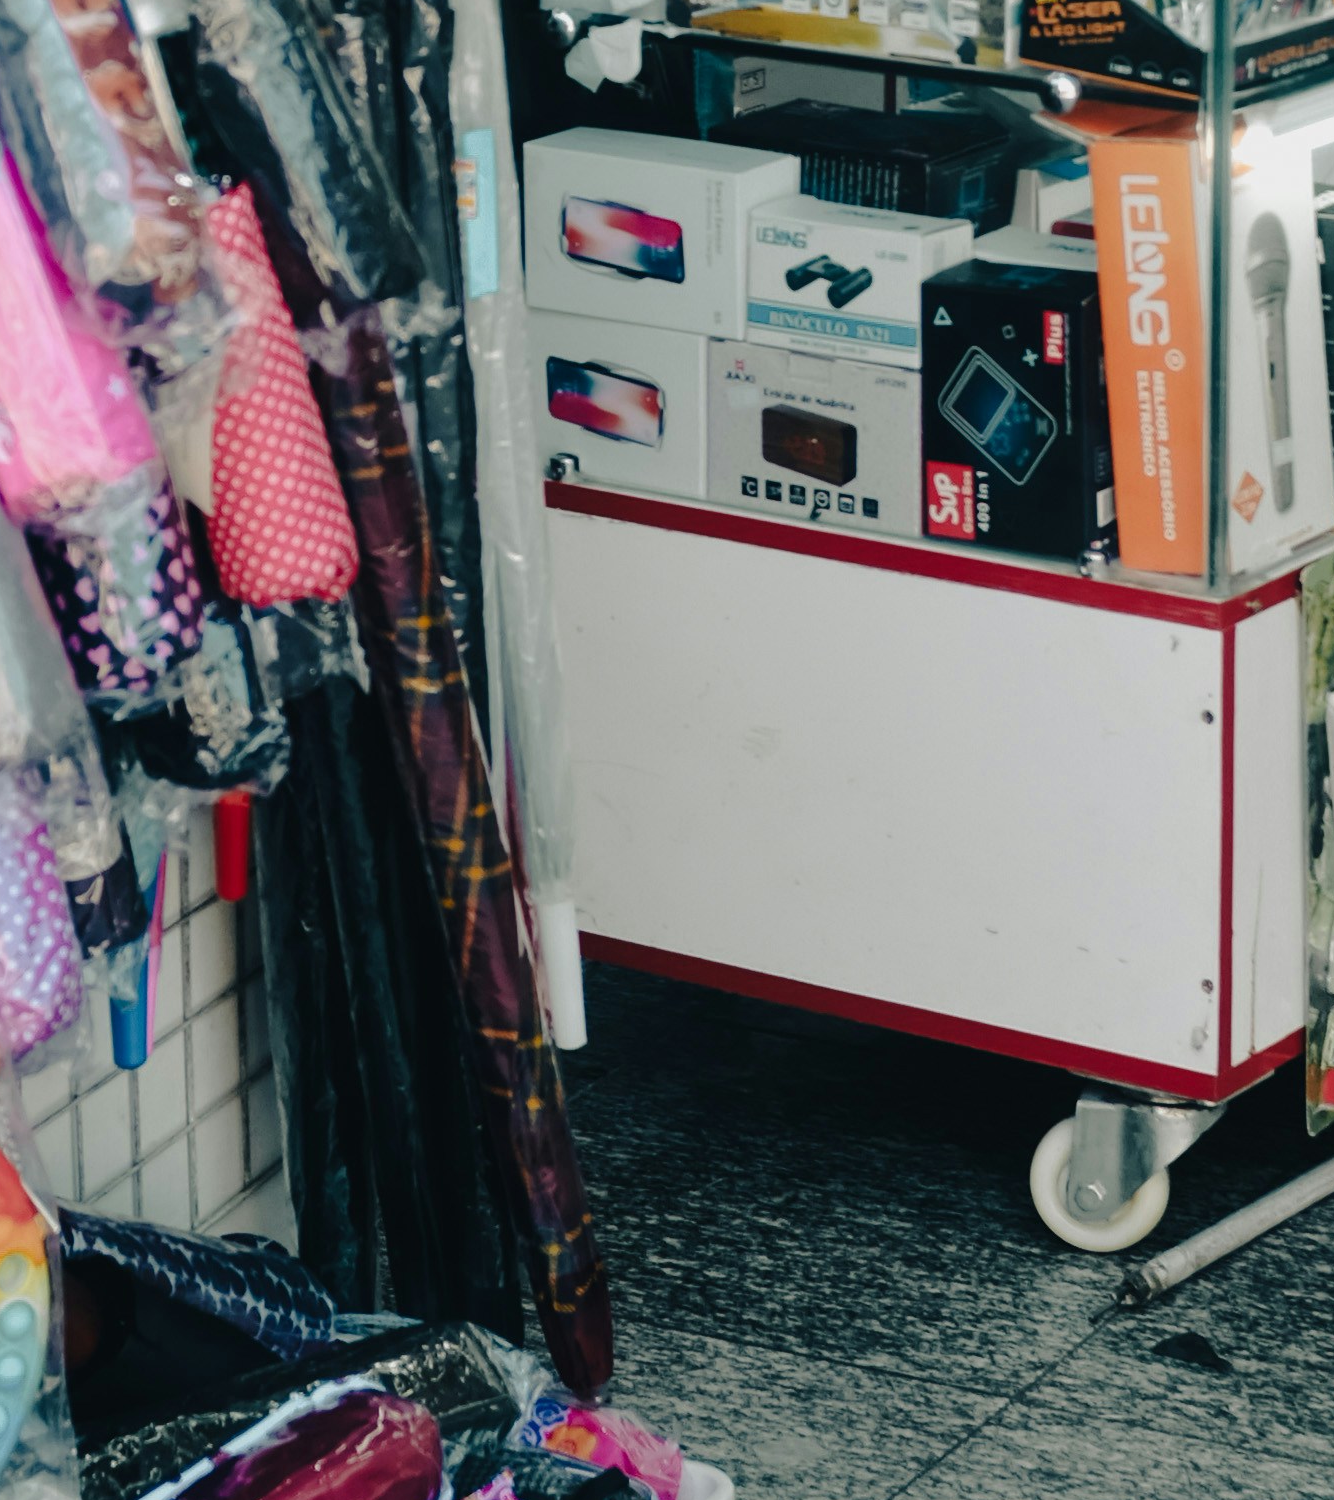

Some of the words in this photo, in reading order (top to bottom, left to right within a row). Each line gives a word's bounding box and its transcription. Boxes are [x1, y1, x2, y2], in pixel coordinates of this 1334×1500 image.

[1036, 0, 1123, 24] LASER
[1075, 20, 1126, 36] LIGHT
[1118, 172, 1171, 347] LELONG
[768, 307, 849, 336] BINÓCULO
[1046, 313, 1064, 359] Plus
[1134, 369, 1158, 479] ELETRÔNICO
[1148, 369, 1167, 428] MELHOR
[928, 472, 961, 526] Sup
[1155, 430, 1178, 543] ACESSÓRIO
